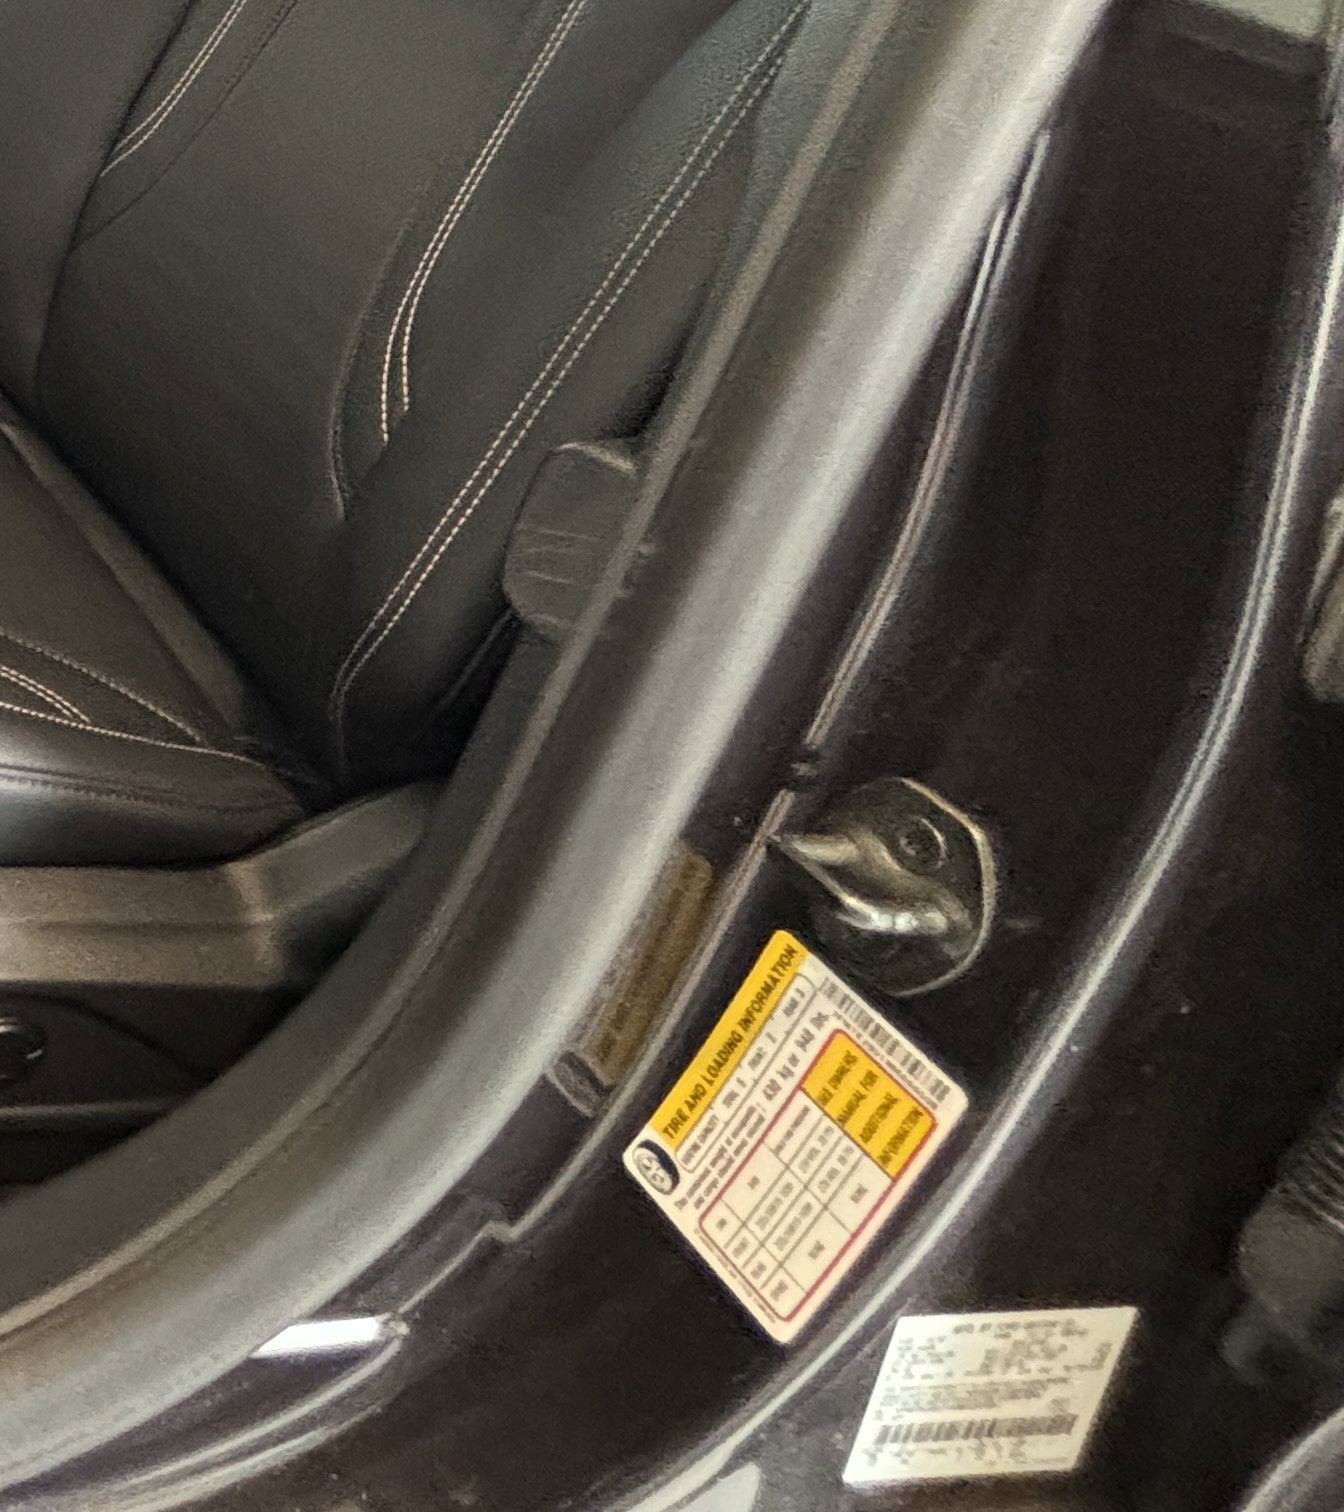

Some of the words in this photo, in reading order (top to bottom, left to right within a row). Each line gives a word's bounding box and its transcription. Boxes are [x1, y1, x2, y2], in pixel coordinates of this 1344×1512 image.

[661, 1106, 690, 1143] TIRE
[681, 1079, 708, 1114] AND
[700, 1027, 744, 1087] LOADING
[734, 942, 800, 1033] INFORMATION
